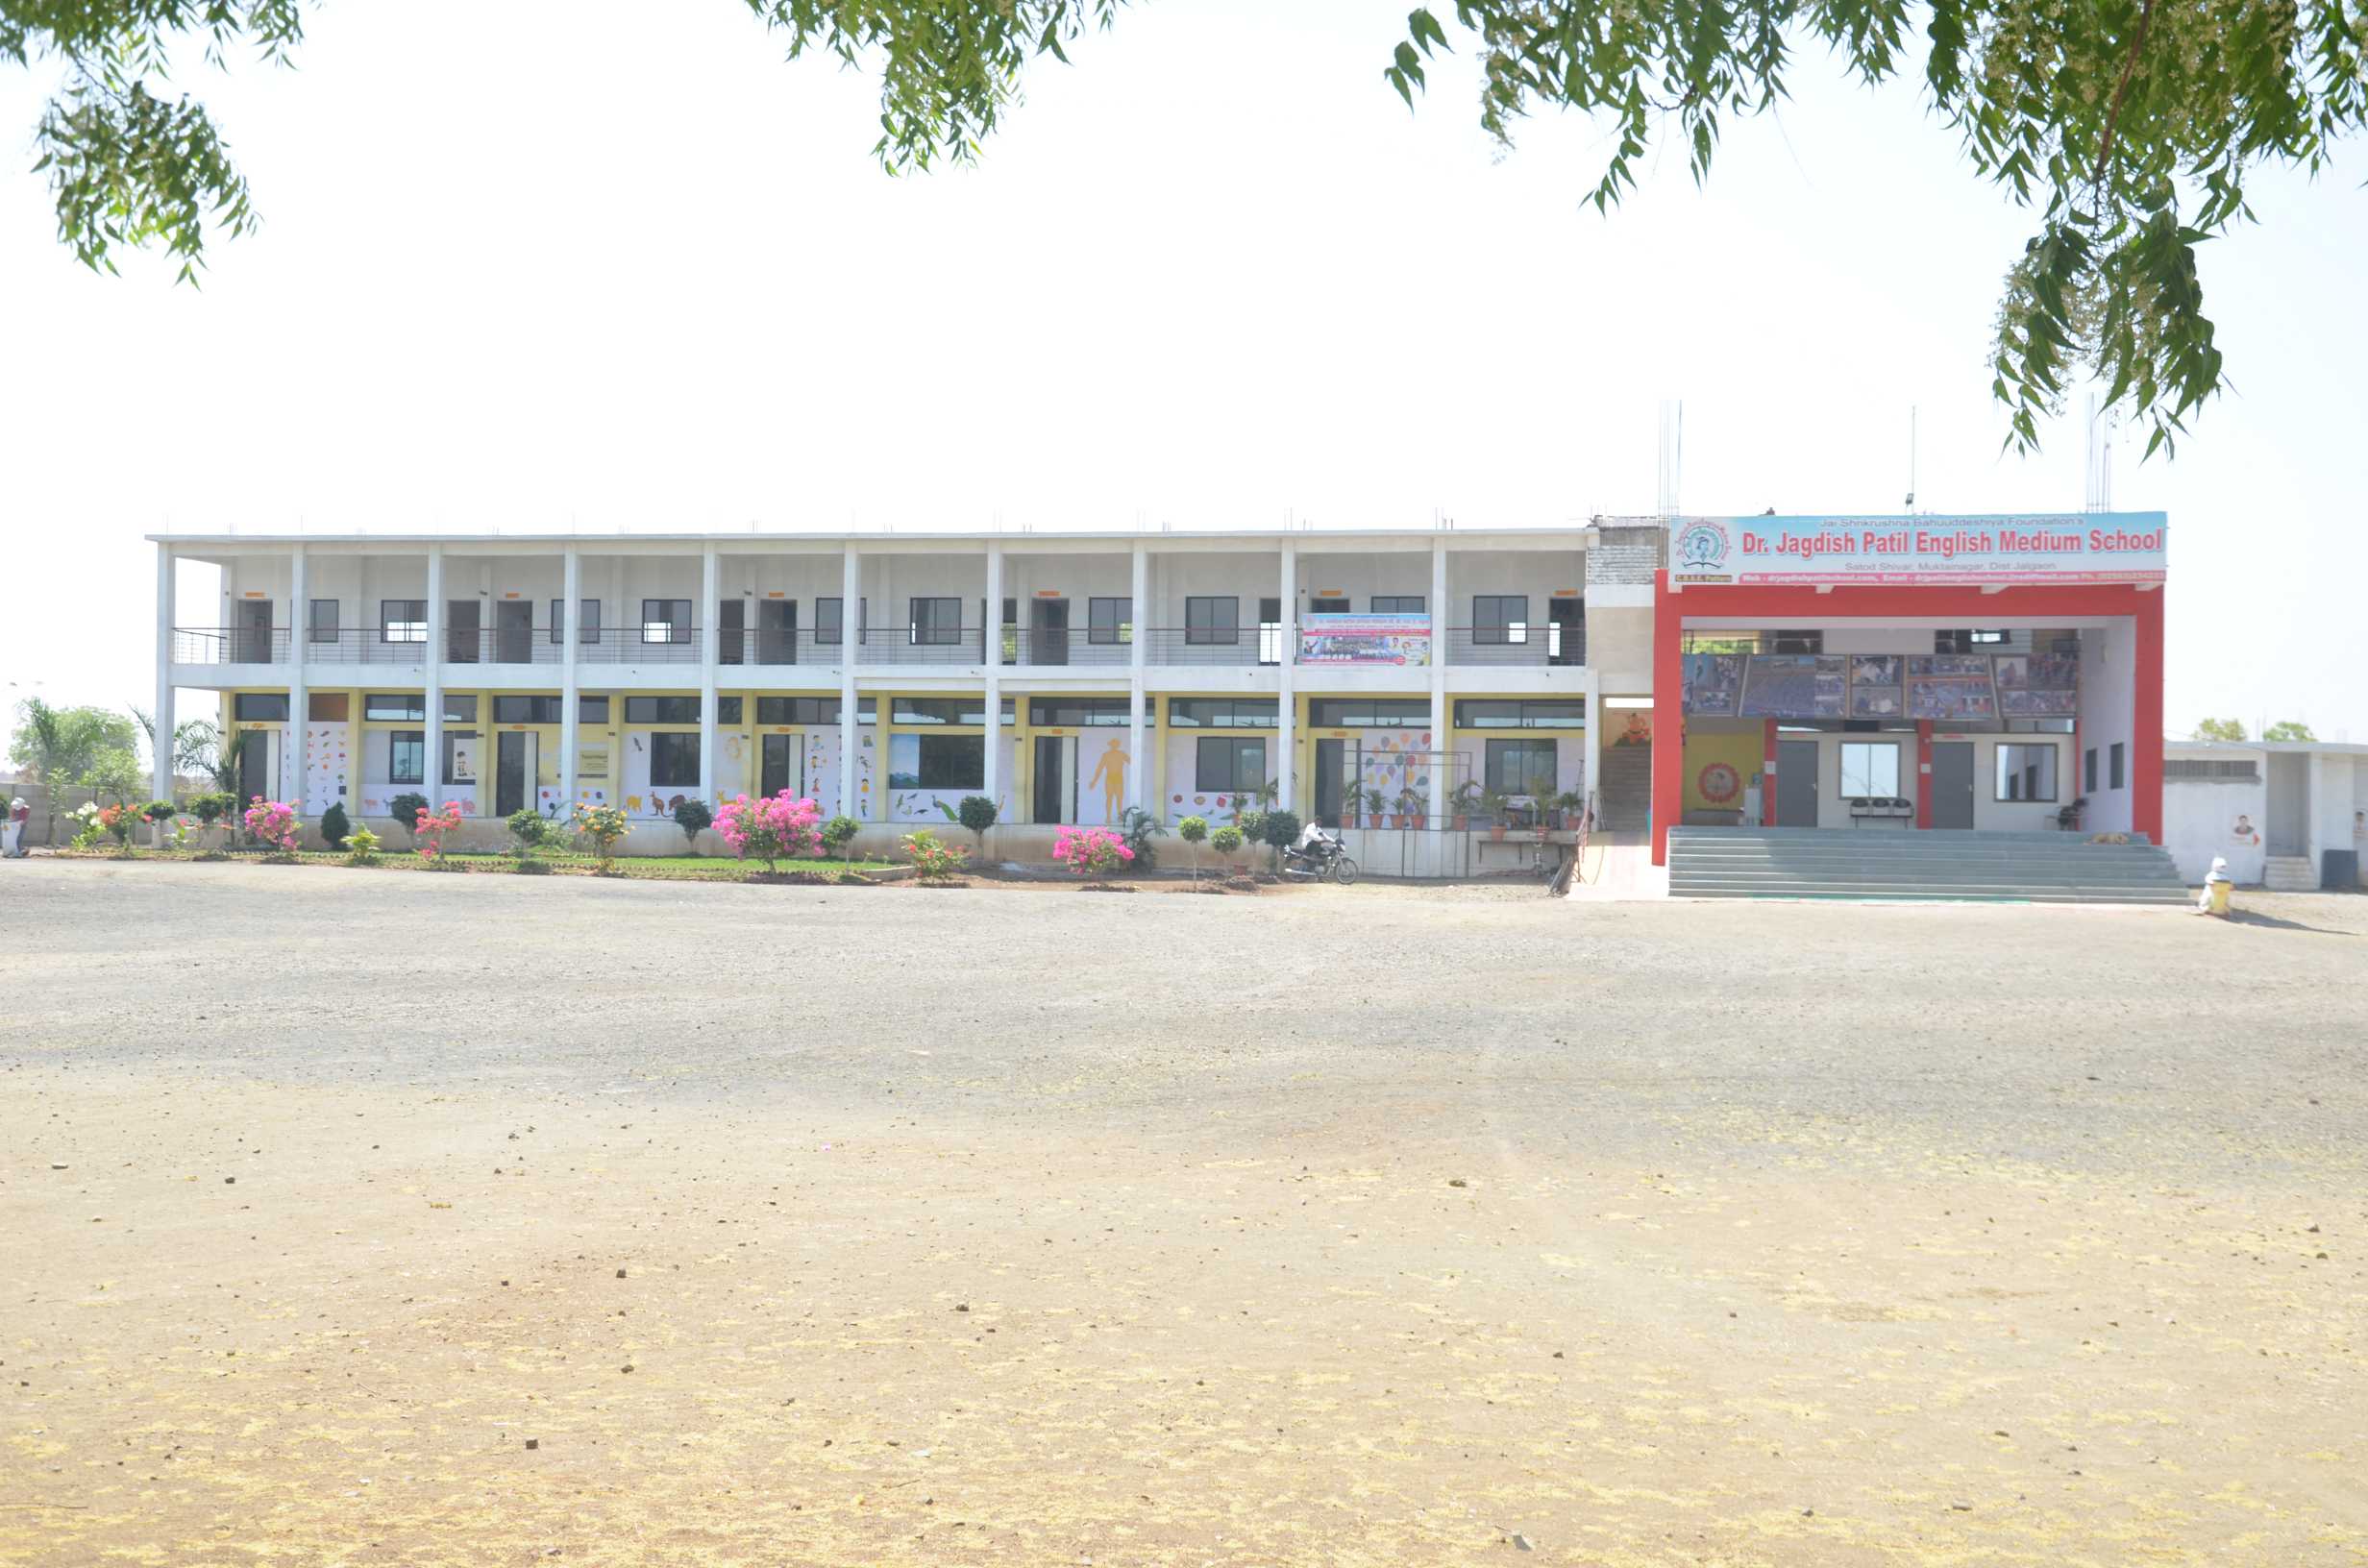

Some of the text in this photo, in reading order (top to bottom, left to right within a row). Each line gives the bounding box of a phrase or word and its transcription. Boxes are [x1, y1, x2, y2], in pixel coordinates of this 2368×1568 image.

[1741, 532, 1769, 553] Dr.
[1776, 531, 1856, 558] Jagdish
[1862, 531, 1909, 553] Patil
[1916, 530, 1991, 557] English
[1999, 530, 2081, 552] Medium
[2089, 528, 2162, 551] School
